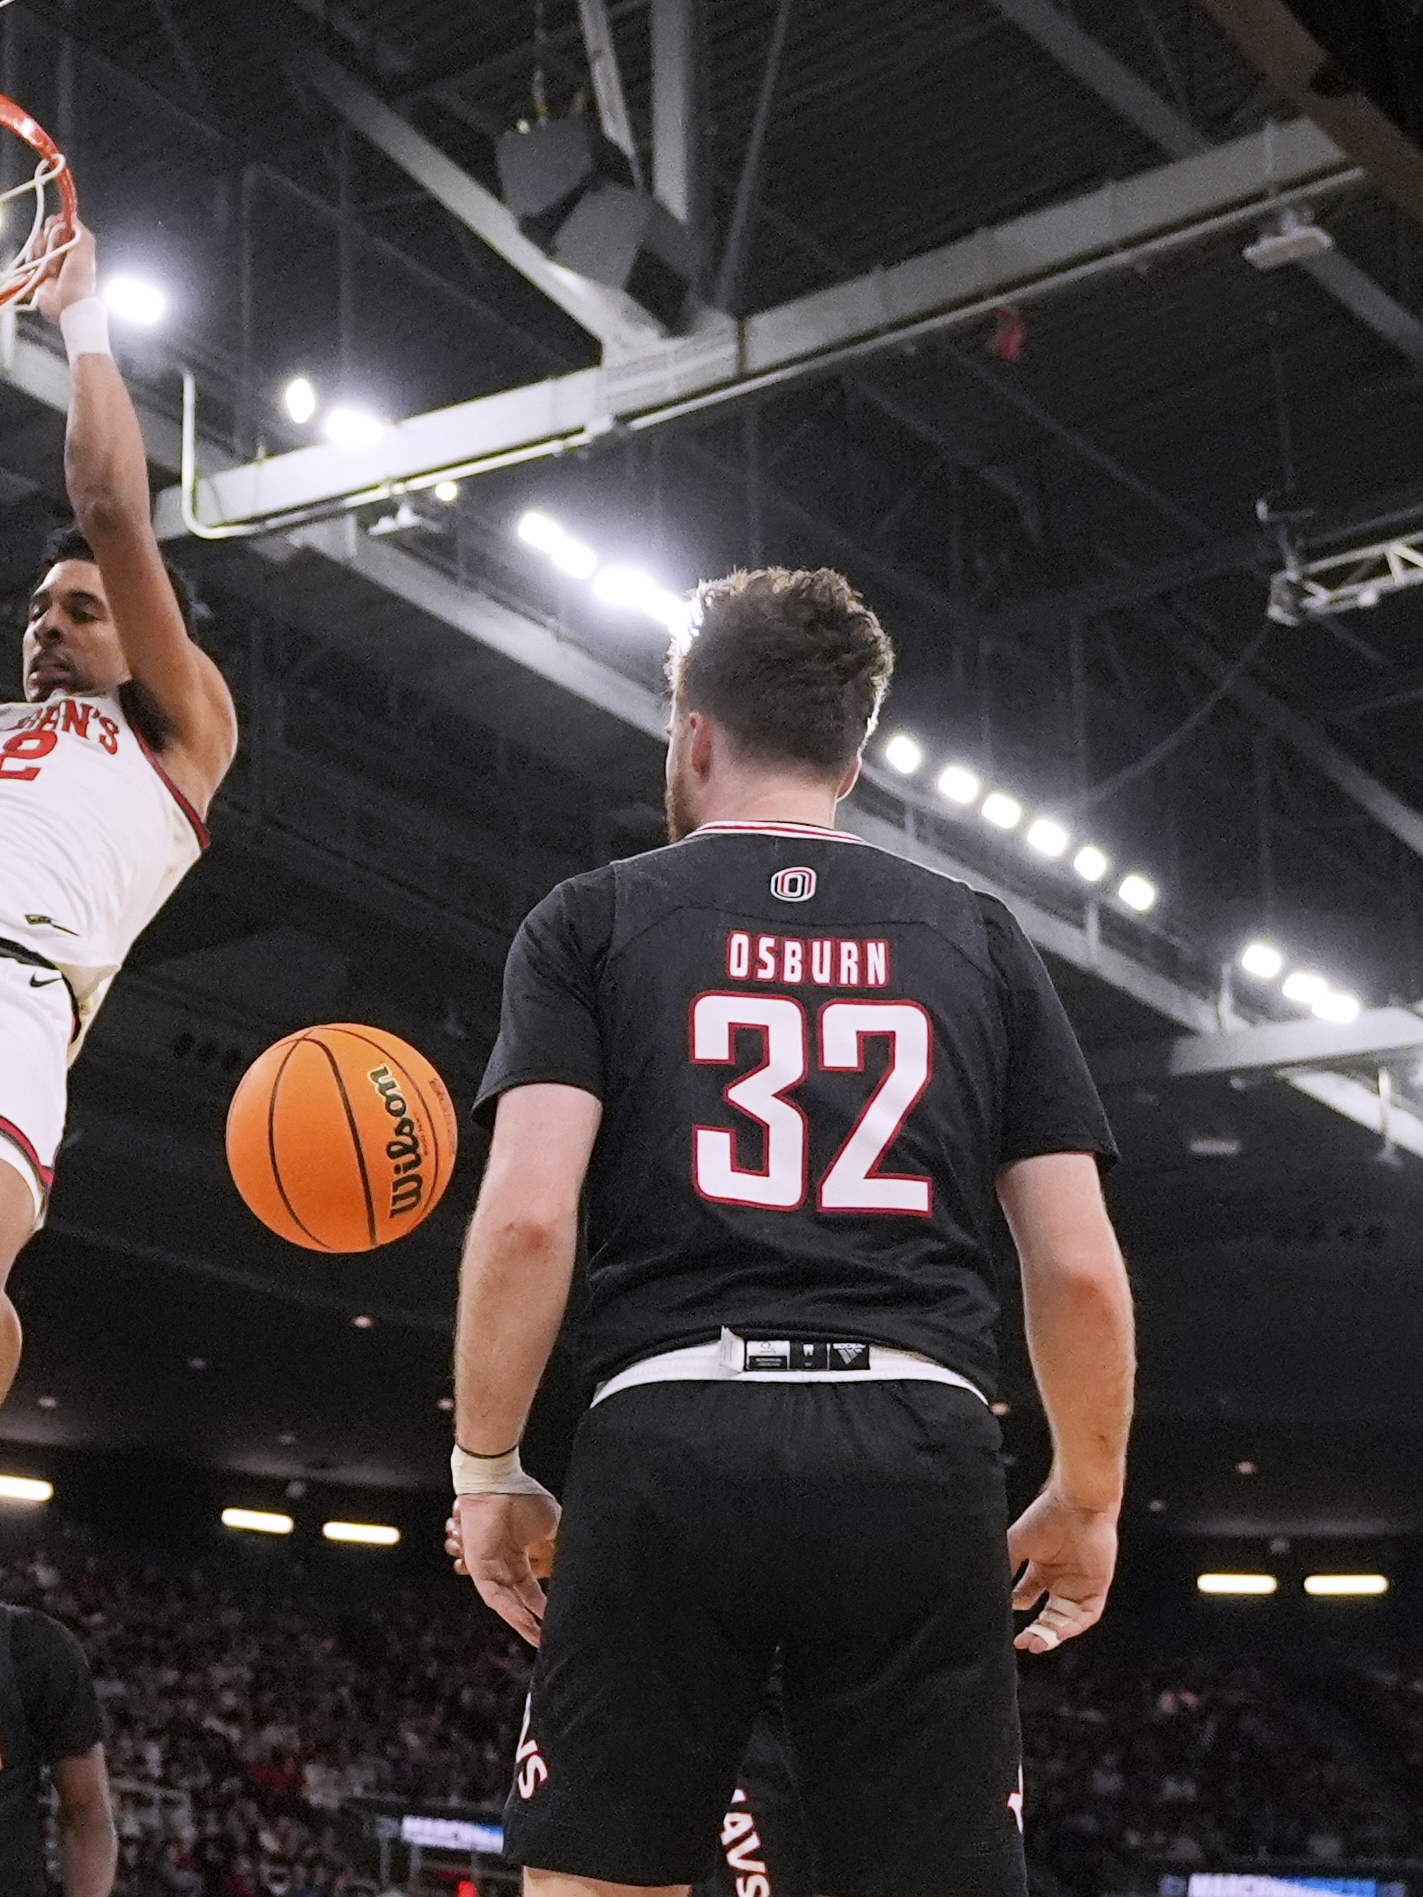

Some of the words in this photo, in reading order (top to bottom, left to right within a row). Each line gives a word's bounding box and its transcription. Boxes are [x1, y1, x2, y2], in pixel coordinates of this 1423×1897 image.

[727, 930, 890, 988] OSBURN
[367, 1062, 424, 1220] Wilson
[689, 989, 933, 1218] 32
